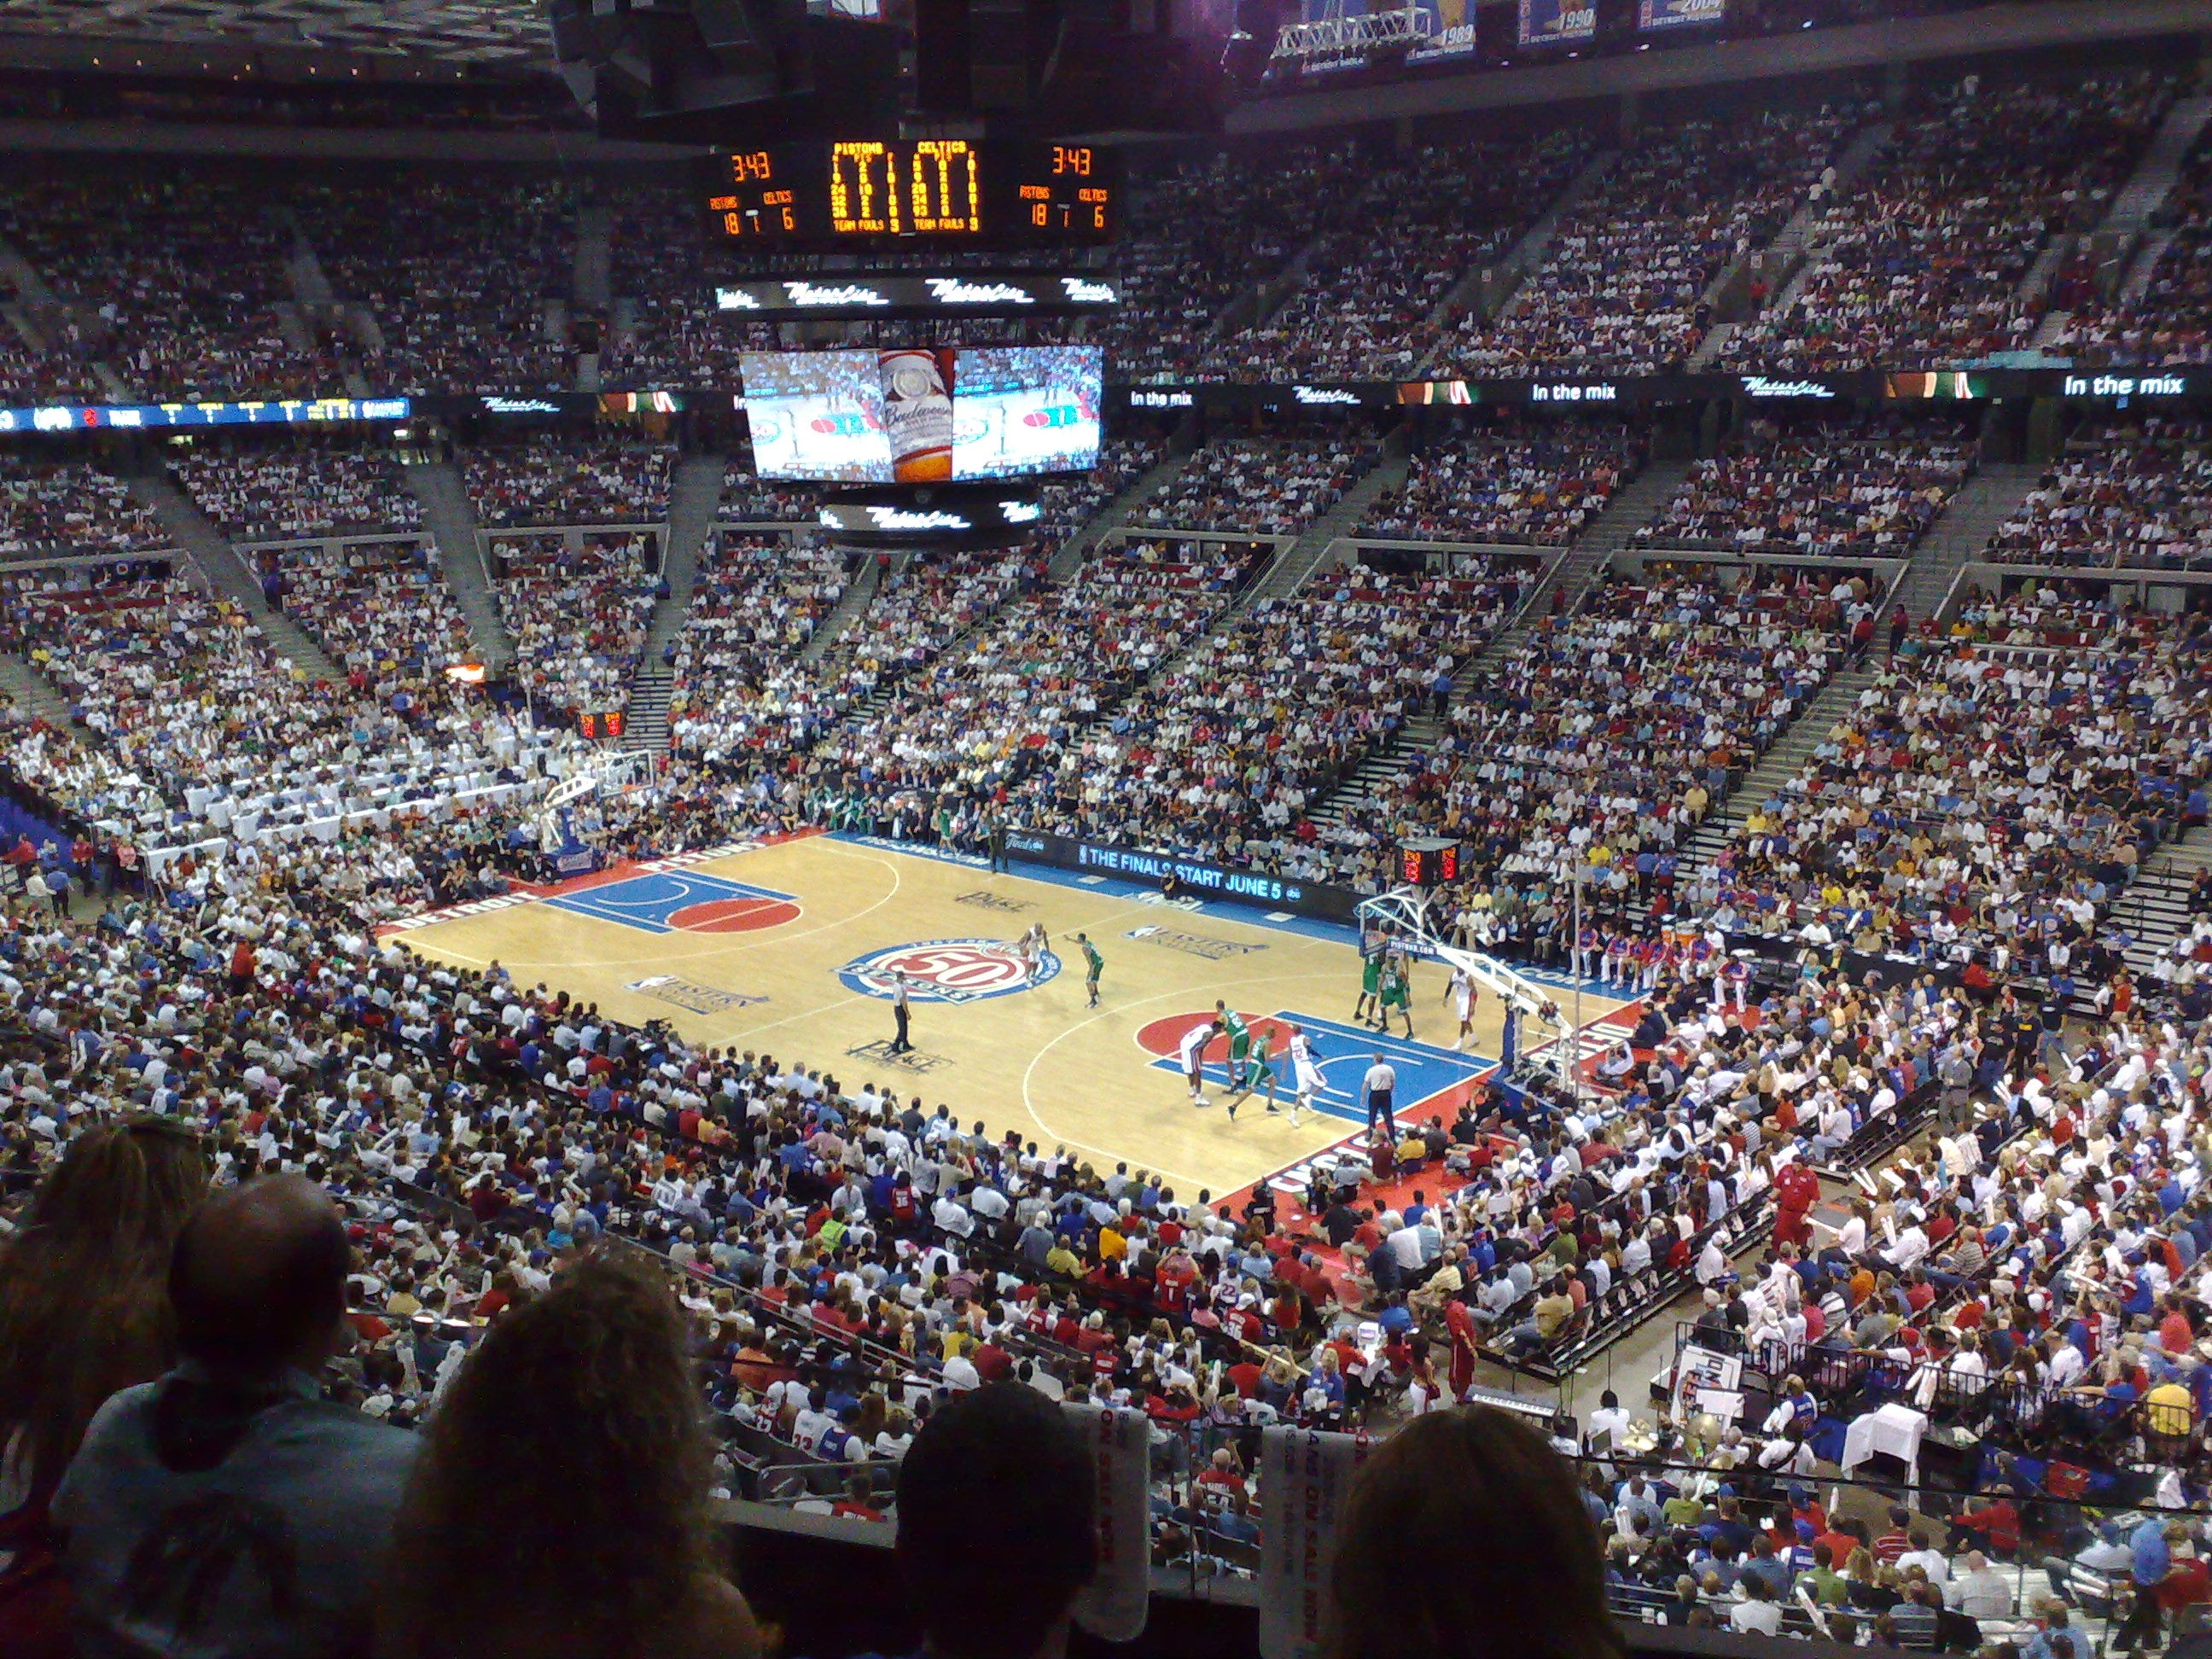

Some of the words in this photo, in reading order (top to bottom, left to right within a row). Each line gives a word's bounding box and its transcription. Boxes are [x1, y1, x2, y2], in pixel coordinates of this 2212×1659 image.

[1557, 9, 1594, 30] 1990
[1441, 25, 1474, 45] 1989
[834, 142, 883, 155] PISTONS
[917, 141, 967, 154] CELTICS
[1052, 146, 1091, 176] 3:43
[830, 183, 847, 195] 24
[911, 194, 928, 206] 34
[724, 212, 741, 235] 18
[783, 207, 795, 230] 6
[913, 218, 936, 231] TEAM
[1032, 203, 1048, 226] 18
[1094, 205, 1104, 228] 6
[1533, 383, 1548, 400] In
[1552, 382, 1580, 401] the
[1586, 381, 1616, 400] mix
[2065, 375, 2085, 395] In
[2093, 375, 2133, 395] the
[2139, 374, 2183, 395] mix
[1131, 391, 1144, 405] In
[1146, 391, 1167, 406] the
[1170, 391, 1193, 406] mix
[1089, 848, 1118, 870] THE
[1174, 864, 1223, 888] START
[1225, 874, 1268, 898] JUNE
[1271, 882, 1282, 900] 5
[392, 891, 541, 929] DETROIT
[890, 952, 1010, 984] 50
